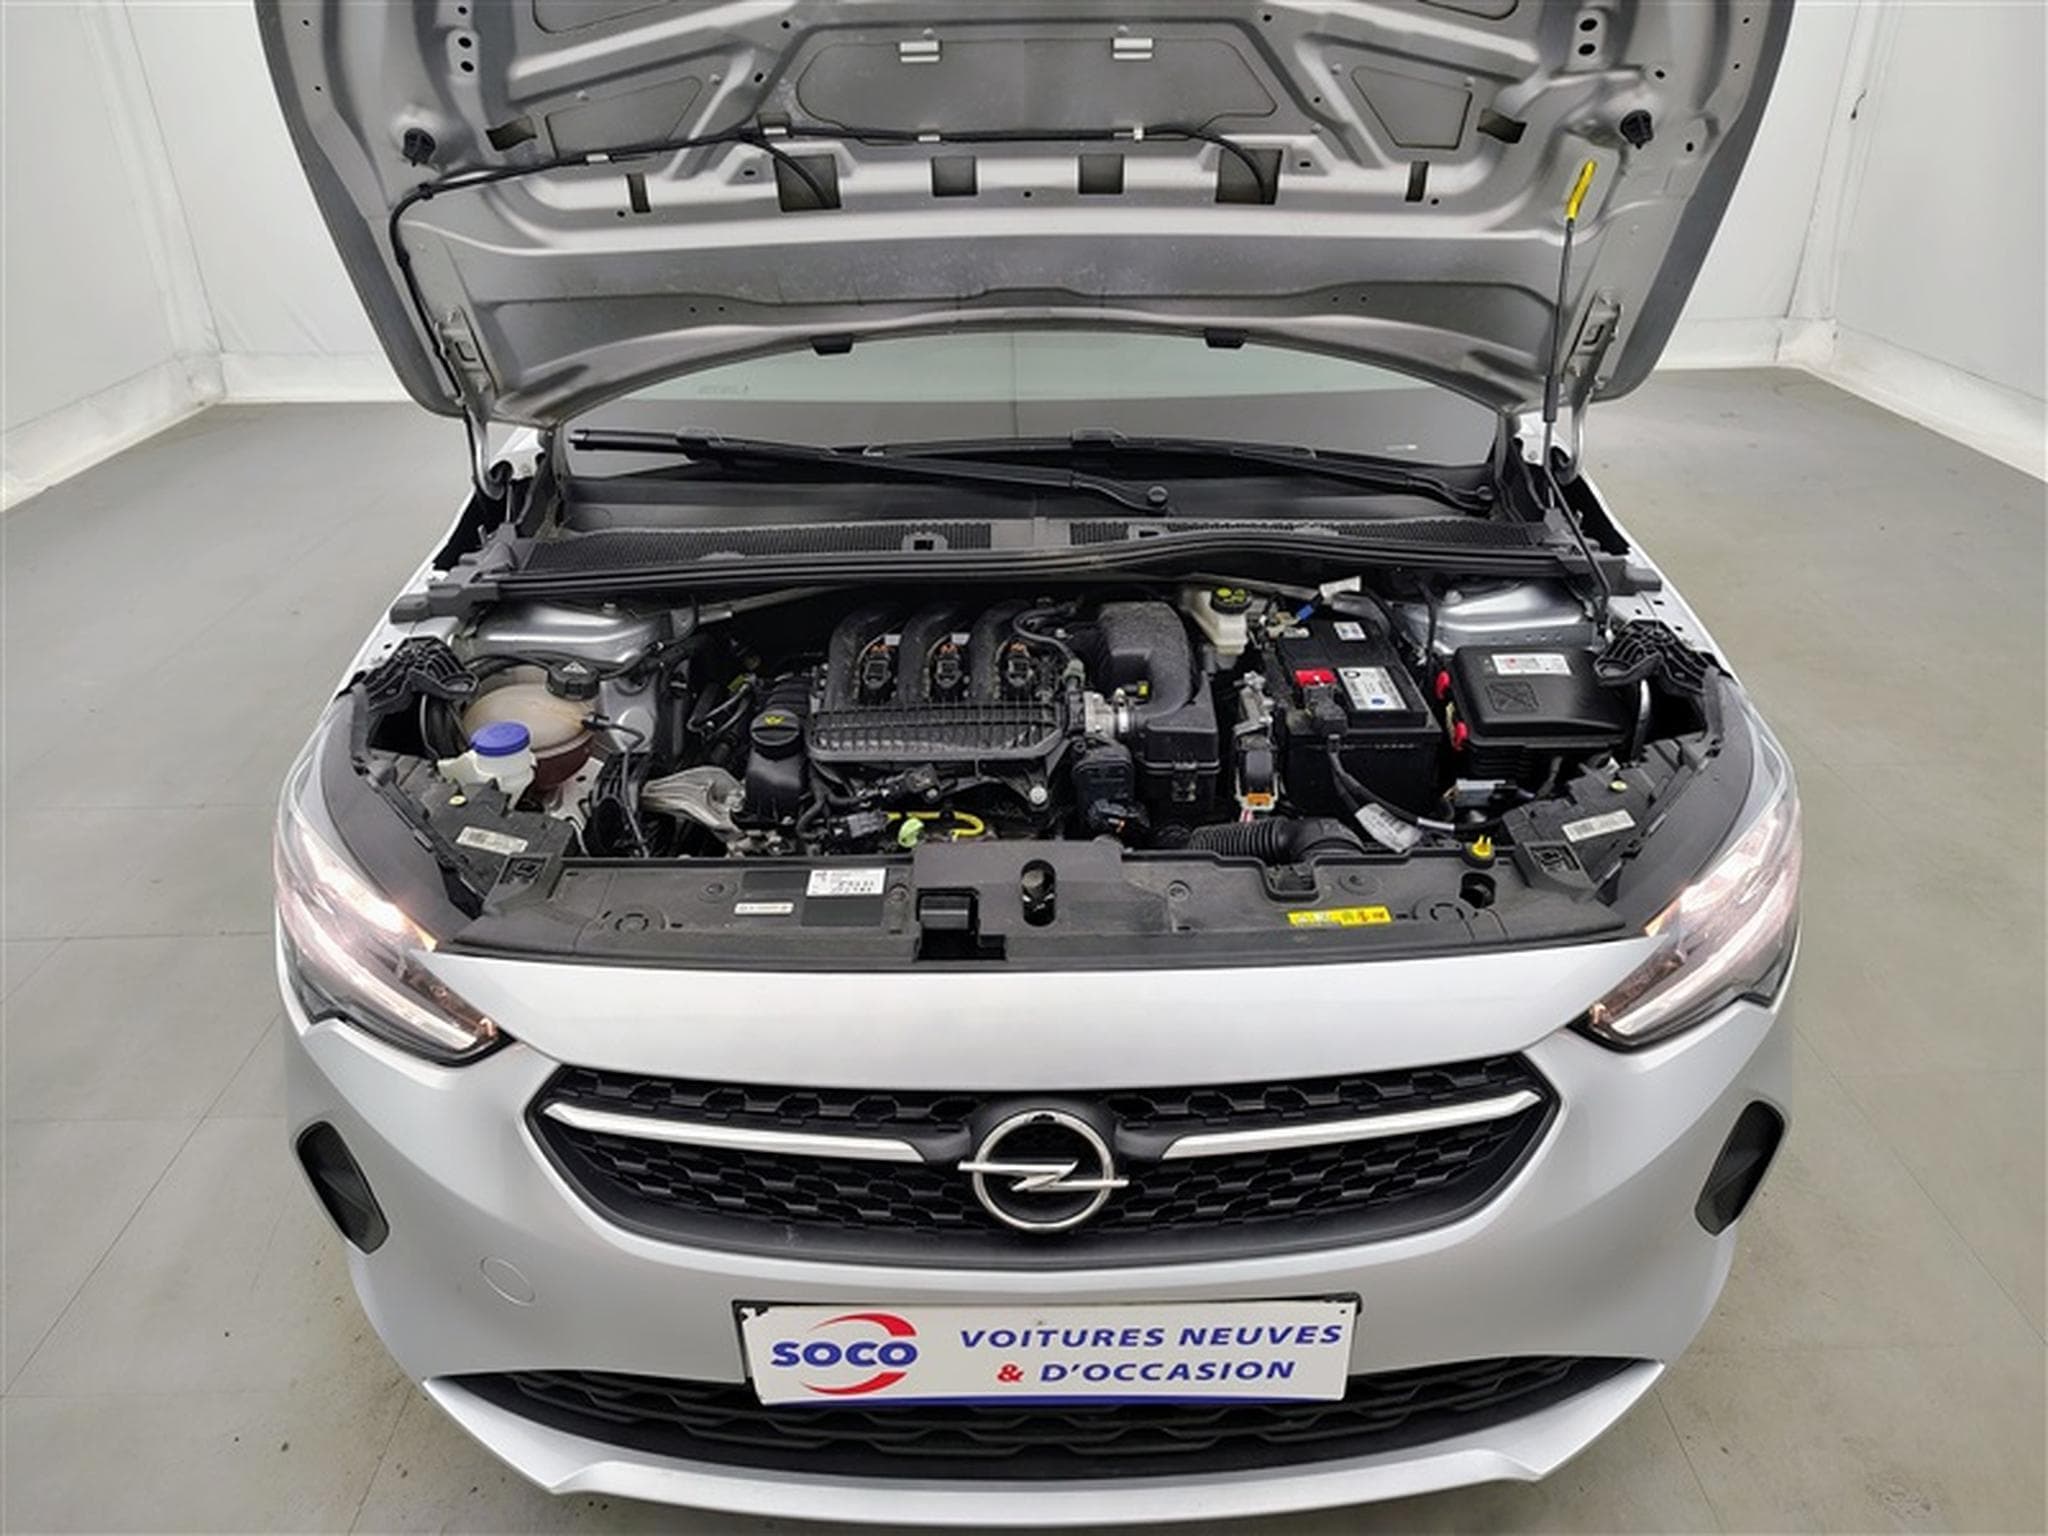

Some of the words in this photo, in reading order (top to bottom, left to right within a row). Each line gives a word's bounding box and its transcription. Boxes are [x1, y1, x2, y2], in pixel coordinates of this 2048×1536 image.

[961, 1328, 1165, 1347] VOITURES
[1178, 1325, 1343, 1345] NEUVES
[772, 1341, 919, 1368] SOCO
[996, 1364, 1024, 1383] &
[1040, 1361, 1295, 1382] D'OCCASION
